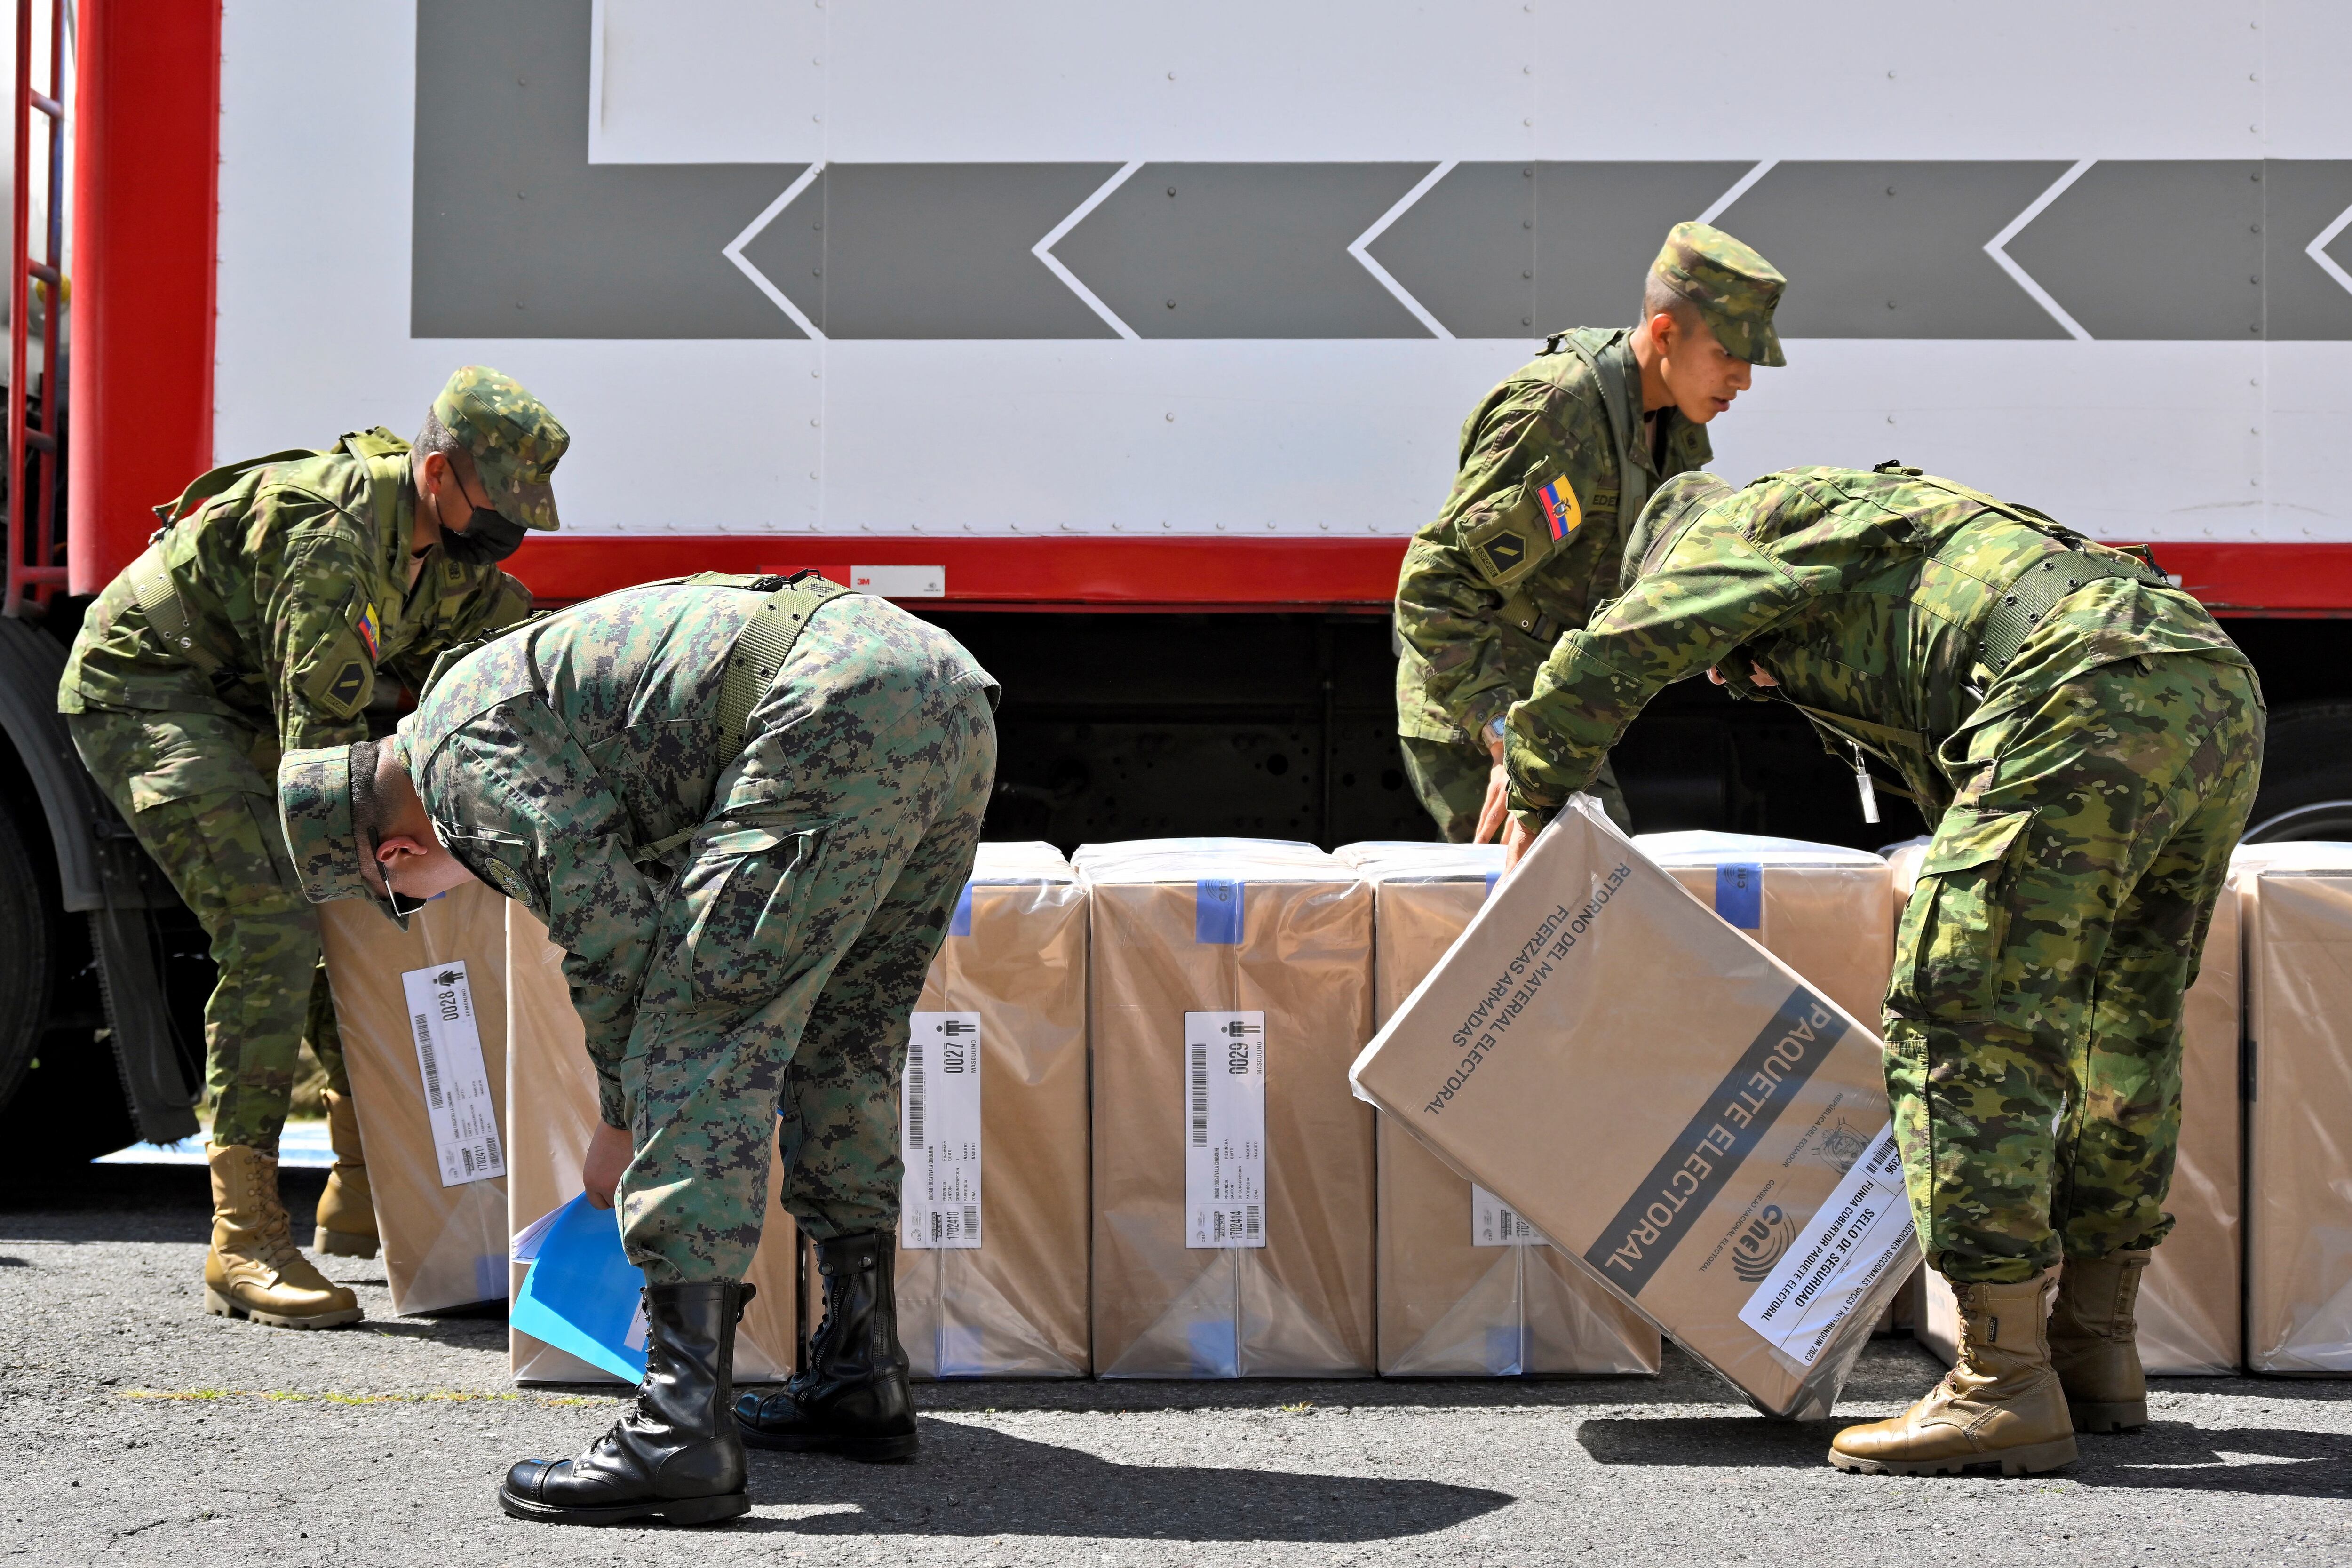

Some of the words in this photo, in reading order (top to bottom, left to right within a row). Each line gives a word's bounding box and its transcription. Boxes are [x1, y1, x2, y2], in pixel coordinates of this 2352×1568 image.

[1592, 494, 1616, 507] EDE
[1476, 548, 1498, 576] ESFORSE
[1569, 862, 1632, 936] RETORNO
[1508, 904, 1569, 976] FUERZAS
[1545, 931, 1577, 965] DEL
[437, 990, 459, 1021] 0028
[1449, 970, 1517, 1050] ARMADAS
[1488, 960, 1554, 1037] MATERIAL
[944, 1042, 964, 1073] 0027
[1229, 1043, 1248, 1074] 0029
[1721, 1000, 1831, 1129] PAQUETE
[1422, 1031, 1497, 1120] ELECTORAL
[1814, 1091, 1845, 1128] REPÚBLICA
[1805, 1125, 1817, 1138] DEL
[473, 1145, 487, 1171] 1702411
[1782, 1137, 1808, 1168] ECUADOR
[1883, 1153, 1904, 1176] 2396
[1604, 1122, 1735, 1280] ELECTORAL
[1749, 1178, 1775, 1209] CONSEJO
[1848, 1179, 1875, 1209] FUNDA
[946, 1211, 959, 1239] 1702410
[1230, 1211, 1242, 1239] 1702414
[1516, 1218, 1529, 1237] 1702
[1725, 1206, 1753, 1239] NACIONAL
[1819, 1205, 1854, 1248] COBERTOR
[1846, 1206, 1875, 1240] SELLO
[1889, 1217, 1918, 1251] LECCIONES
[1698, 1237, 1729, 1274] ELECTORAL
[1835, 1237, 1852, 1254] DE
[1791, 1244, 1824, 1282] PAQUETE
[1859, 1248, 1893, 1289] SECCIONALES,
[1793, 1251, 1841, 1309] SEGURIDAD
[1844, 1285, 1864, 1306] CPCCS
[1760, 1278, 1797, 1323] ELECTORAL
[1813, 1308, 1846, 1348] REFERENDUM
[1803, 1345, 1819, 1362] 2023
